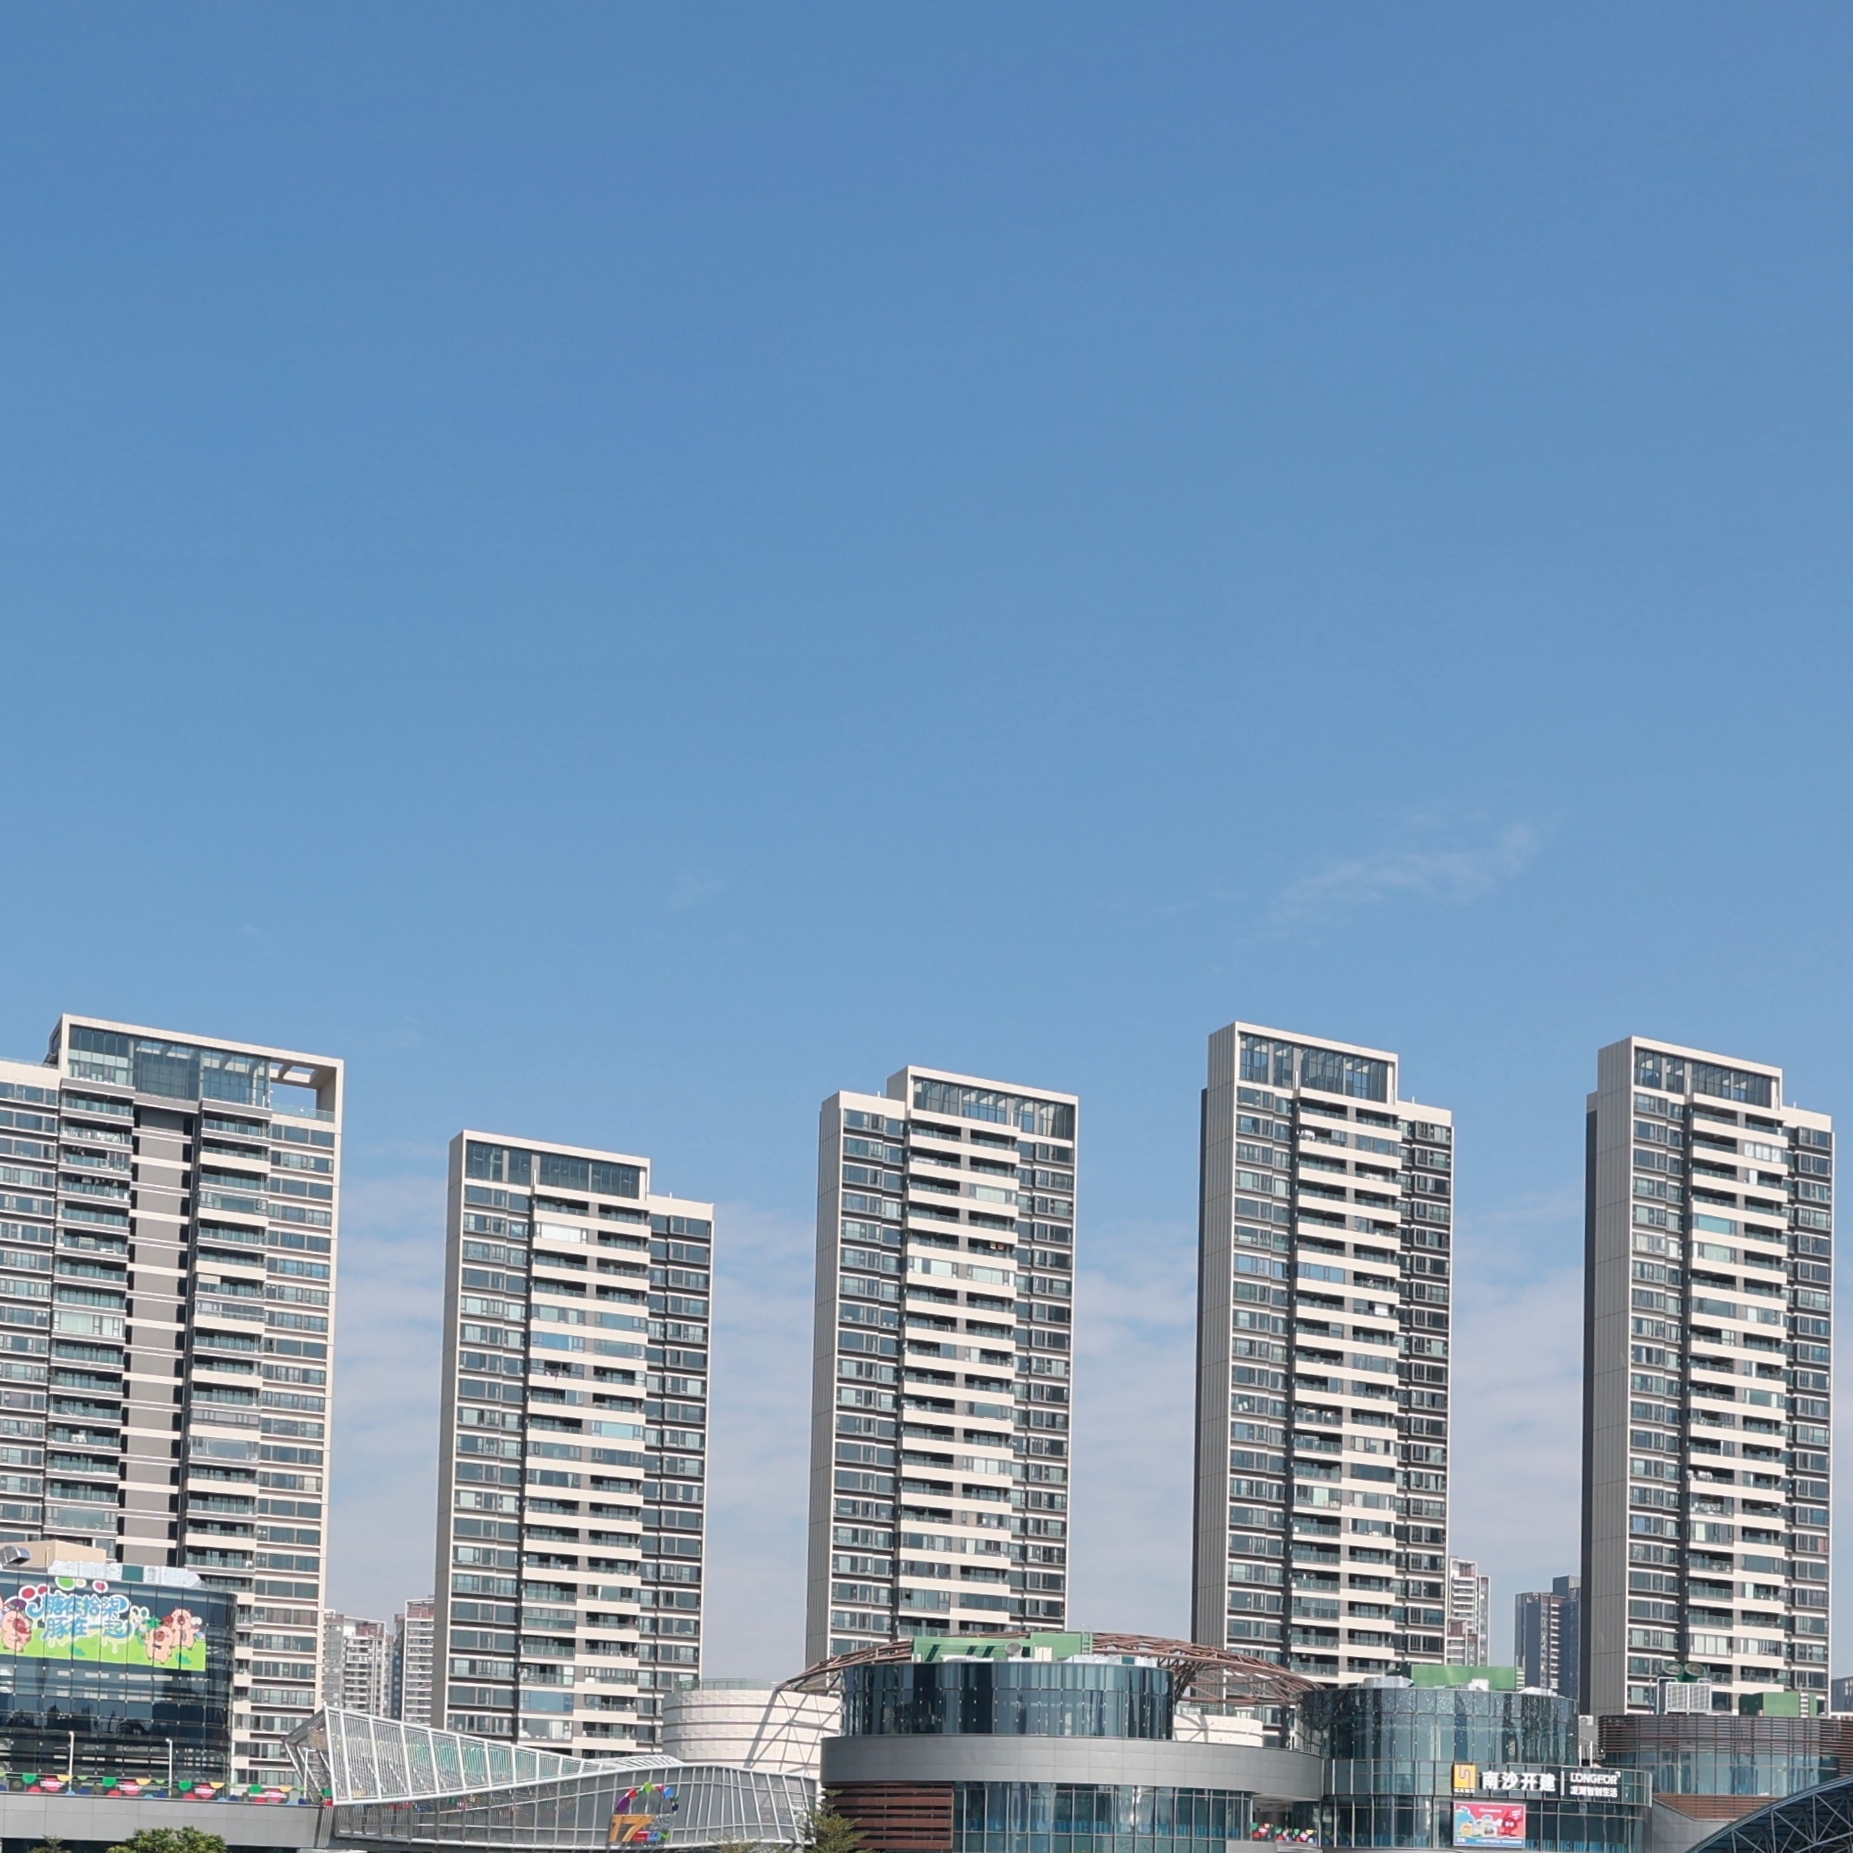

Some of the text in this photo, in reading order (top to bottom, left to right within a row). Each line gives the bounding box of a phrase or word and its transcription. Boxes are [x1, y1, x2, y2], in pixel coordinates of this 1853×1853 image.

[1481, 1771, 1556, 1792] 南沙开建
[1570, 1772, 1617, 1785] LONGFOR
